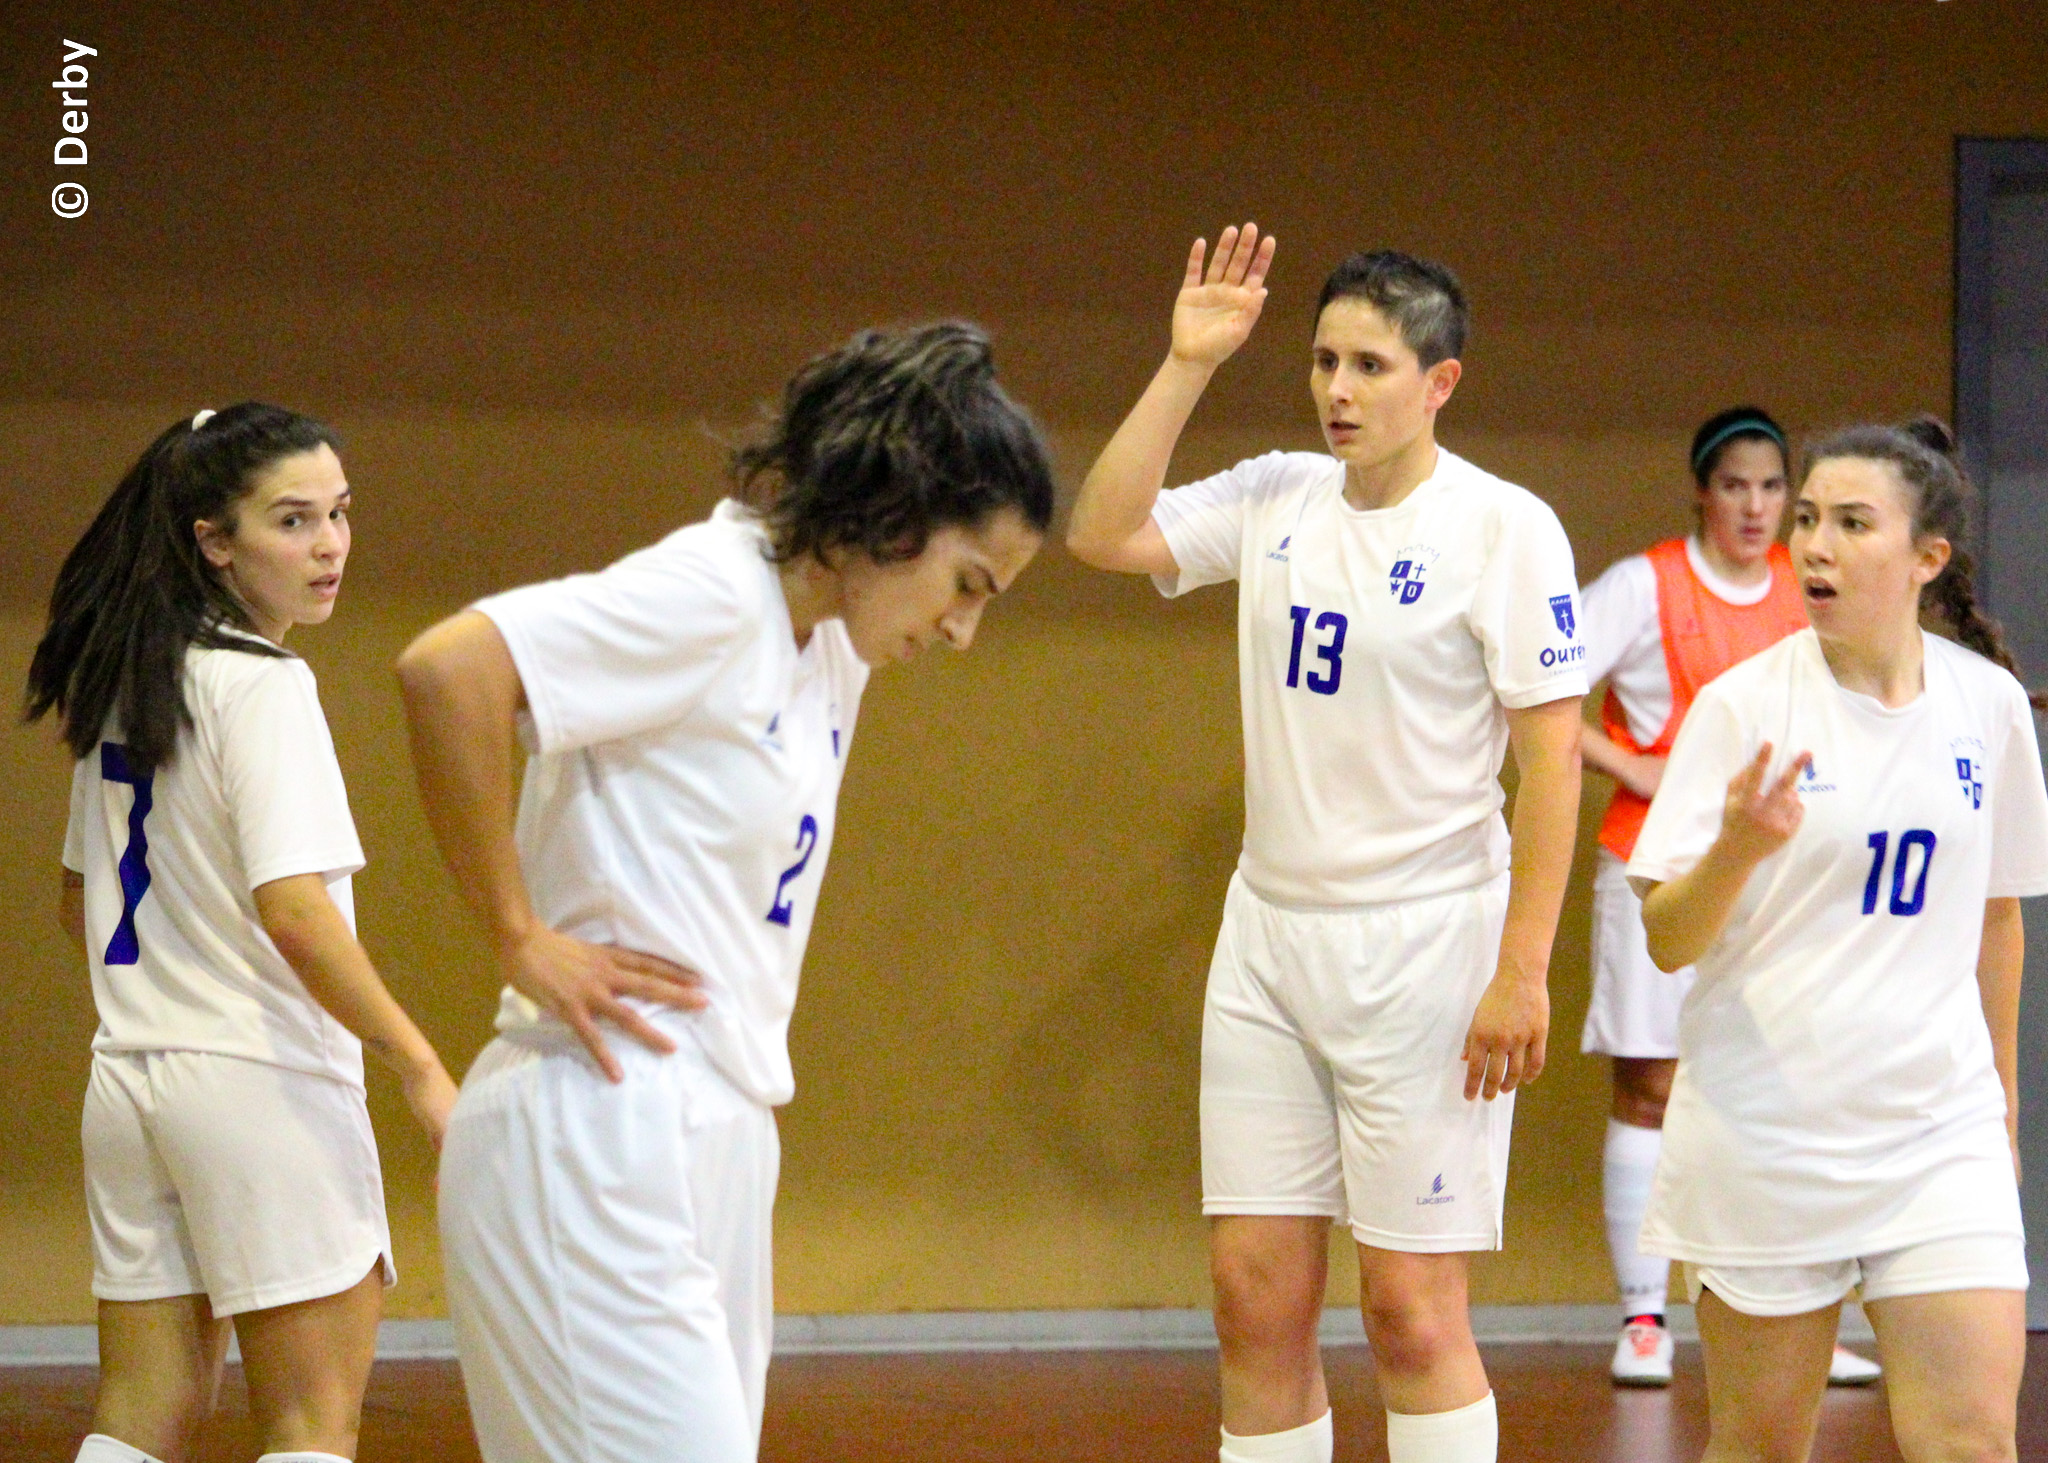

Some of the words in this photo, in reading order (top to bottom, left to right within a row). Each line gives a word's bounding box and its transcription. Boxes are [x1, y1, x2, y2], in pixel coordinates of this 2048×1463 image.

[1286, 605, 1348, 695] 13
[101, 741, 155, 966] 7
[765, 814, 819, 928] 2
[1861, 829, 1937, 917] 10
